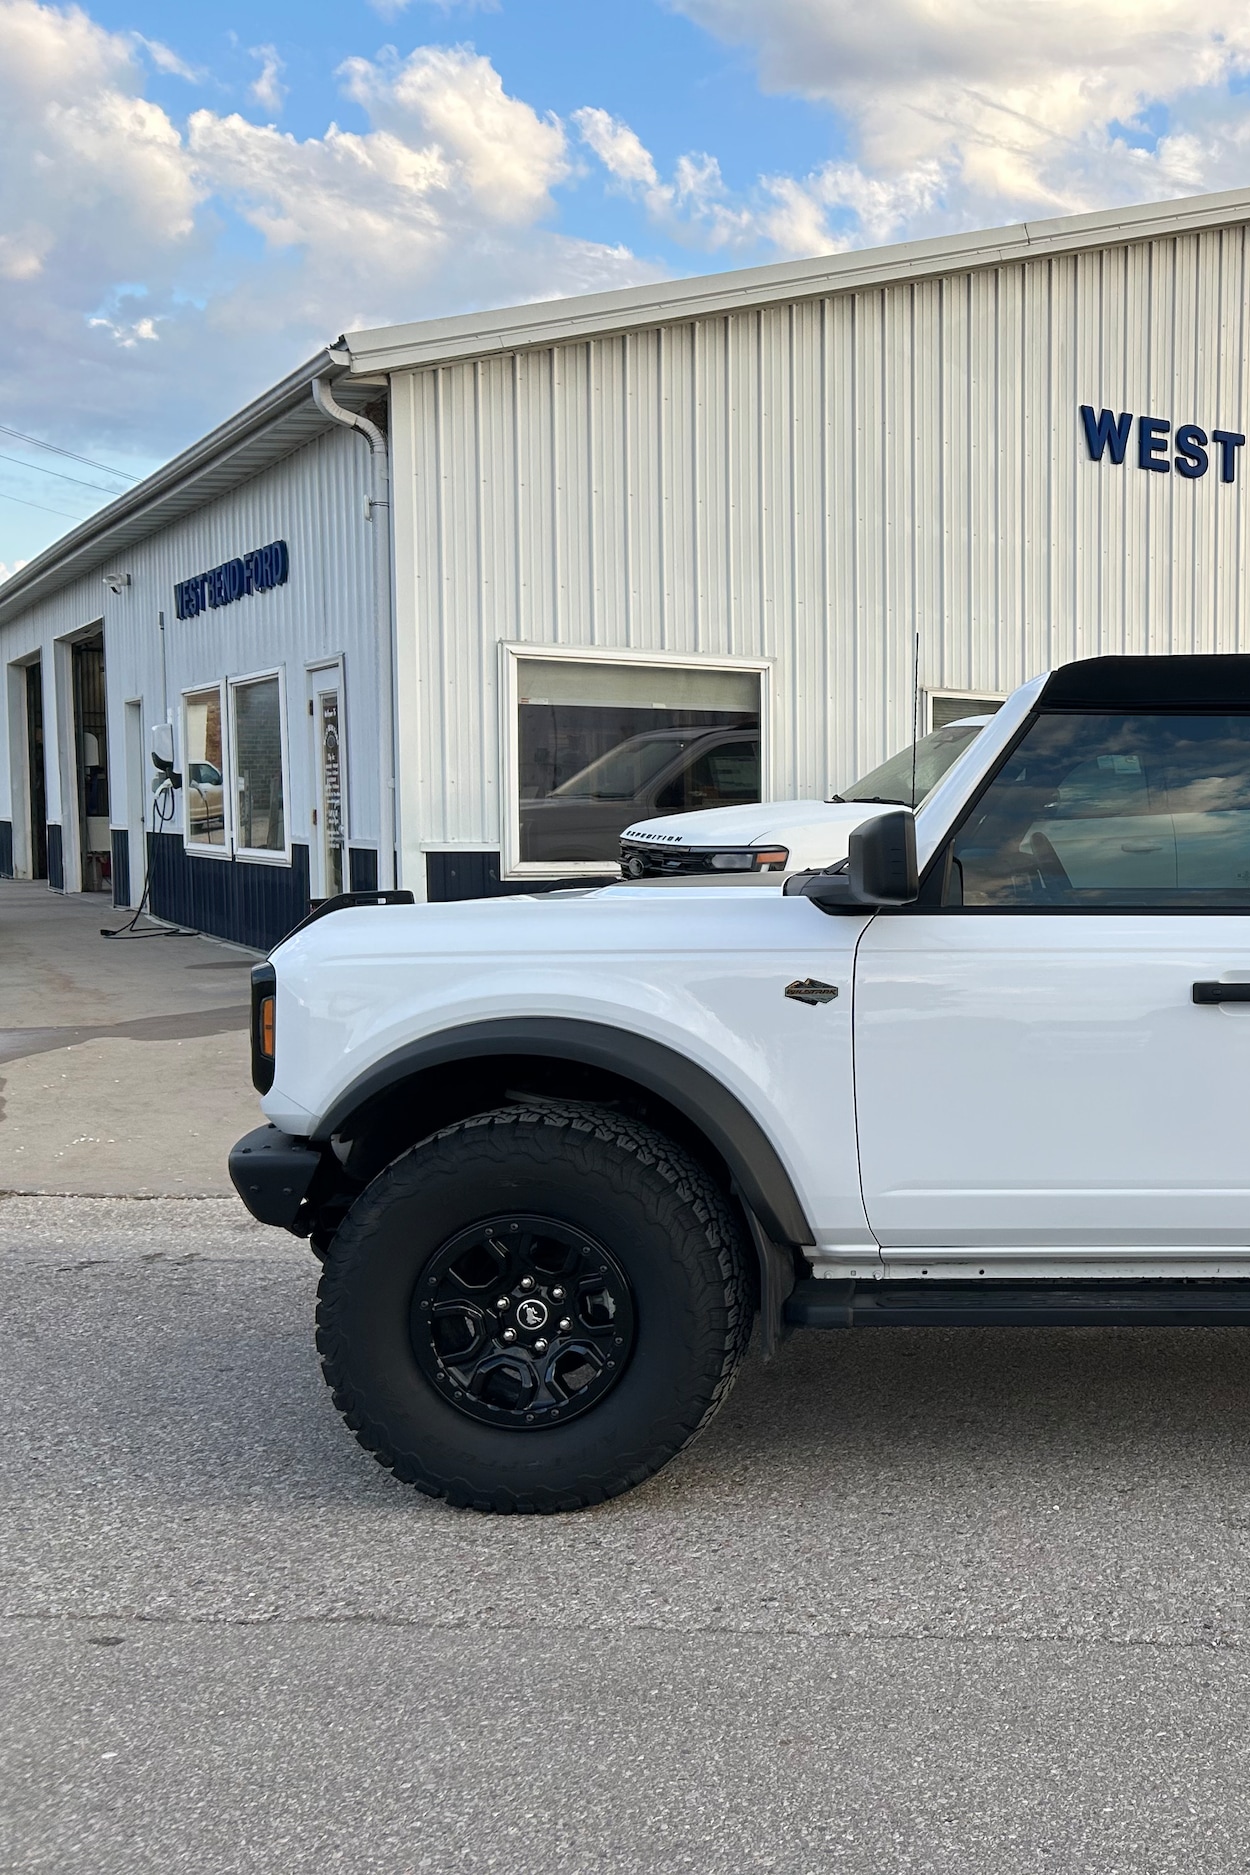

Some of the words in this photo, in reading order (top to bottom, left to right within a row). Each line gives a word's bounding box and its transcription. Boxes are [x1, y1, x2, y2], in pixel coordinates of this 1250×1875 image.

[1081, 404, 1246, 483] WEST
[174, 572, 208, 621] WEST
[207, 557, 245, 610] BEND
[243, 539, 290, 595] FORD
[626, 830, 684, 842] EXPEDITION
